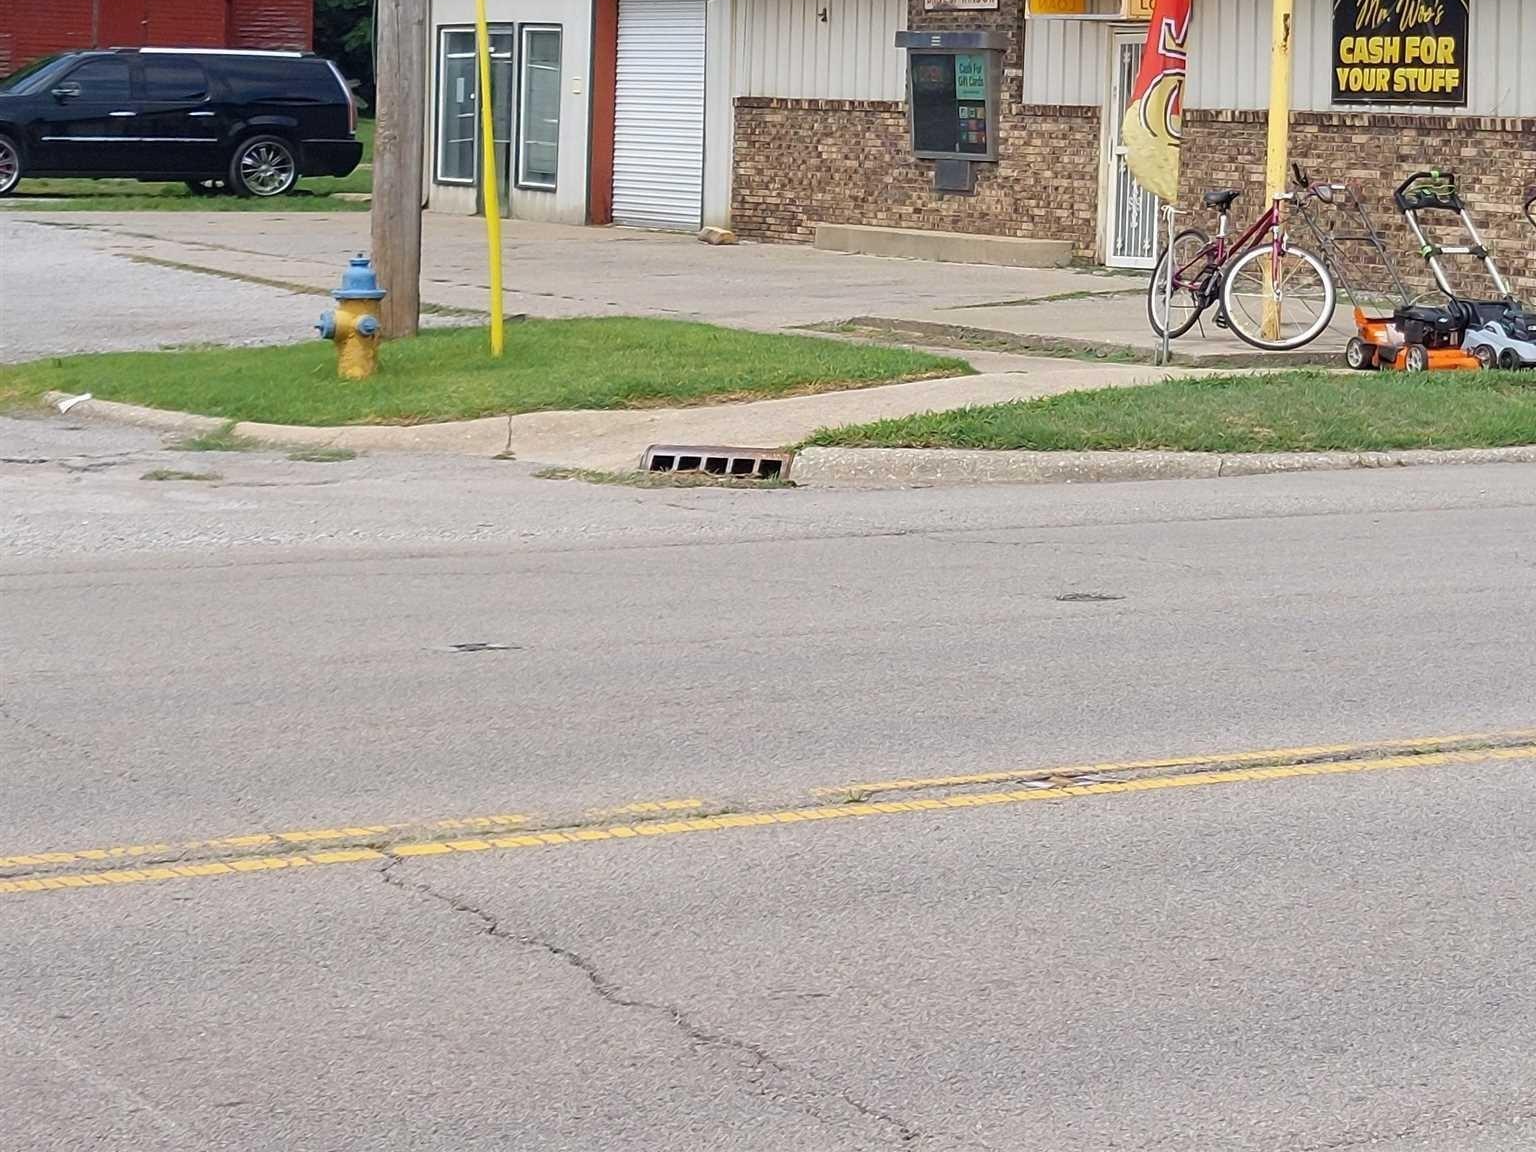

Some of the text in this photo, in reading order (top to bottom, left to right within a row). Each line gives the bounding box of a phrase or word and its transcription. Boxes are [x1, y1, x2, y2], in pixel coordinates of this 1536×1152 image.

[1339, 36, 1455, 64] CASH FOR
[1336, 67, 1460, 92] YOUR STUFF
